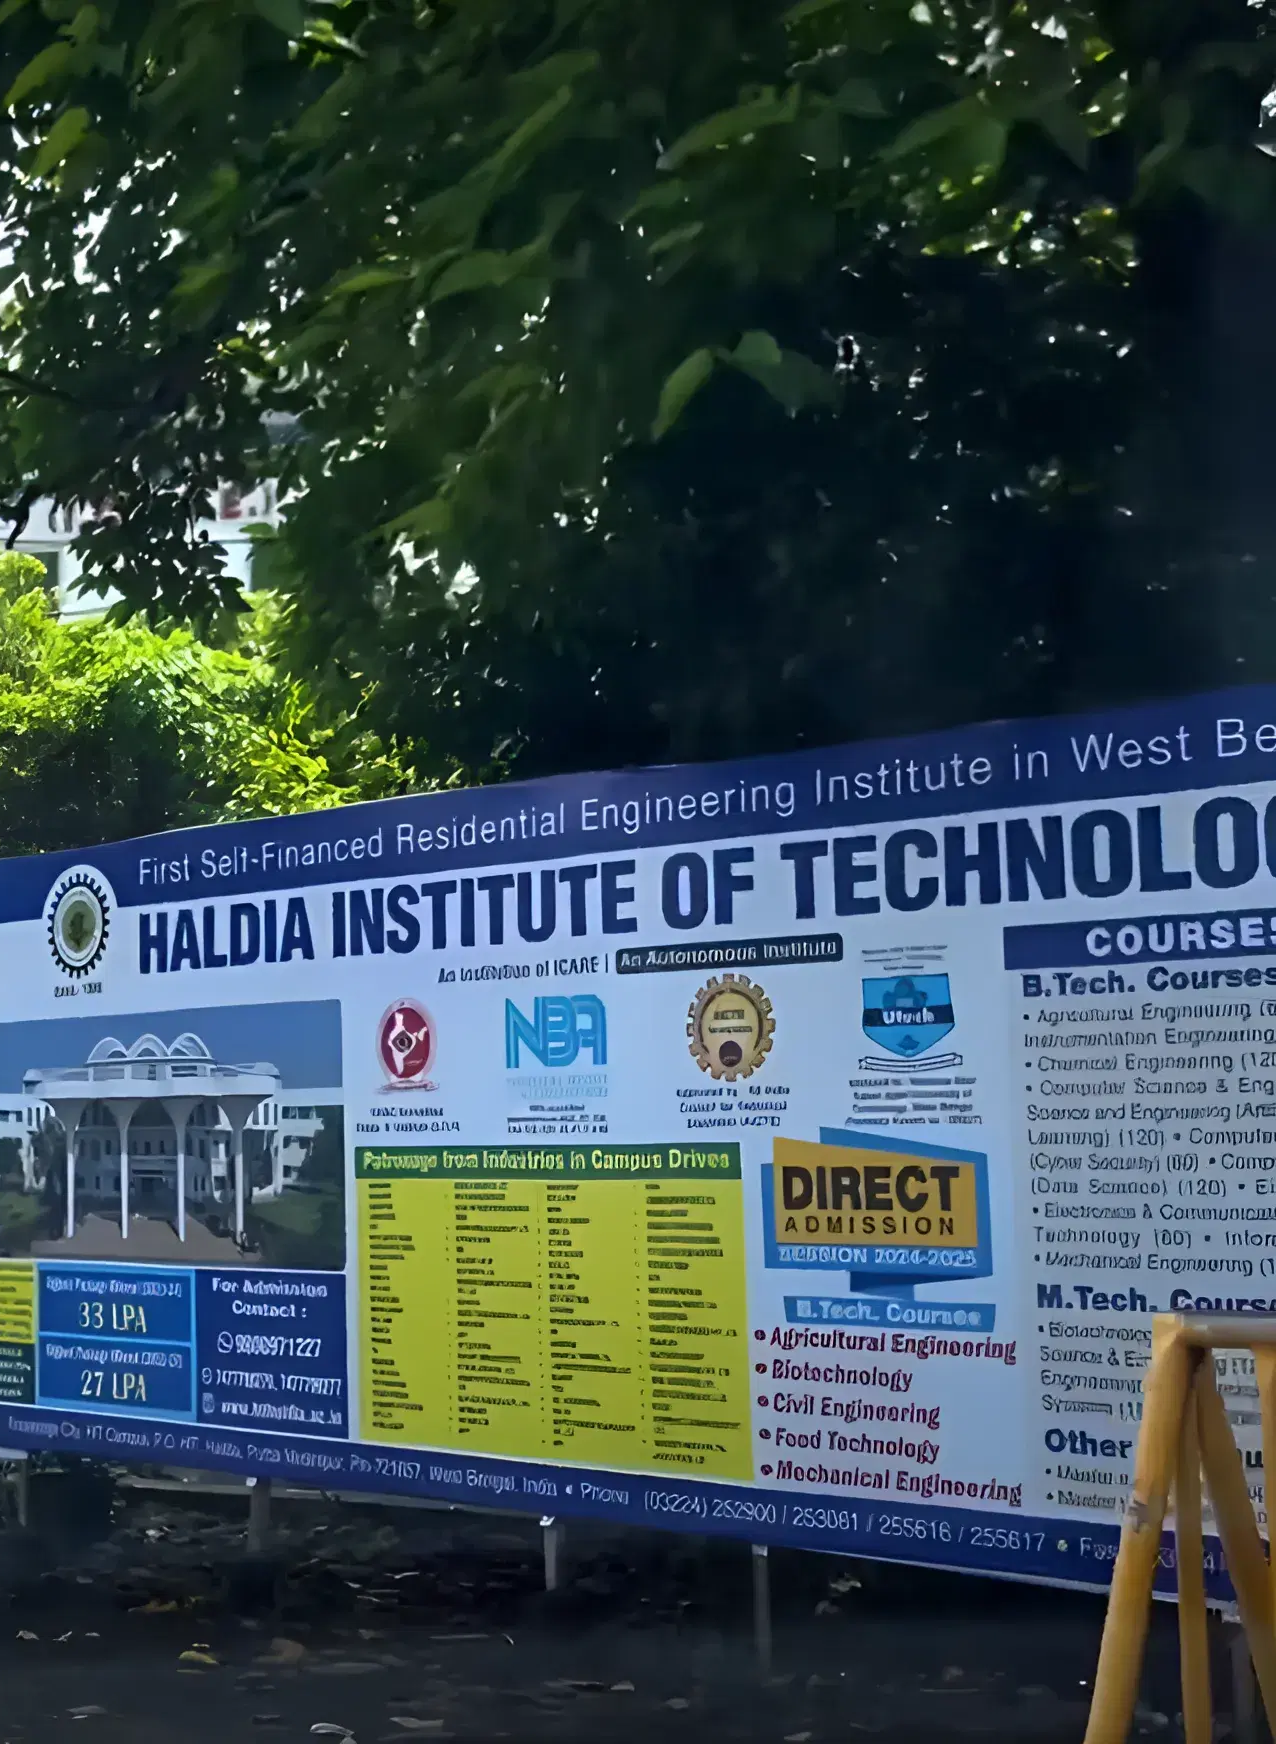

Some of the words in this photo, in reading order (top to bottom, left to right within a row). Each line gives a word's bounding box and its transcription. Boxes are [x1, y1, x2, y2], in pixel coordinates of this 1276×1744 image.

[139, 853, 190, 885] First
[201, 827, 383, 879] Self-Financed
[397, 802, 565, 855] Residential
[581, 779, 795, 834] Engineering
[815, 753, 994, 806] Institute
[1014, 743, 1049, 781] in
[1071, 724, 1192, 773] West
[139, 896, 315, 975] HALDIA
[332, 859, 638, 959] INSTITUTE
[661, 846, 755, 930] OF
[781, 796, 1276, 920] TECHNOLO
[1085, 916, 1276, 957] COURSE
[645, 944, 757, 966] Autonomous
[1022, 970, 1136, 998] B.Tech.
[505, 994, 608, 1070] NBA
[1125, 1053, 1234, 1074] Engineering
[1095, 1102, 1126, 1120] and
[782, 1164, 959, 1213] DIRECT
[784, 1215, 955, 1236] ADMISSION
[1037, 1283, 1158, 1312] M.Tech.
[78, 1301, 104, 1329] 33
[111, 1302, 147, 1334] LPA
[769, 1327, 886, 1352] Agricultural
[890, 1332, 1017, 1366] Engineering
[81, 1369, 104, 1397] 27
[112, 1372, 147, 1402] LPA
[772, 1358, 913, 1393] Biotechnology
[773, 1392, 814, 1416] Civil
[820, 1396, 941, 1430] Engineering
[775, 1427, 821, 1450] Food
[827, 1430, 940, 1465] Technology
[1044, 1427, 1133, 1459] Other
[776, 1460, 890, 1490] Mechanical
[896, 1470, 1023, 1507] Engineering
